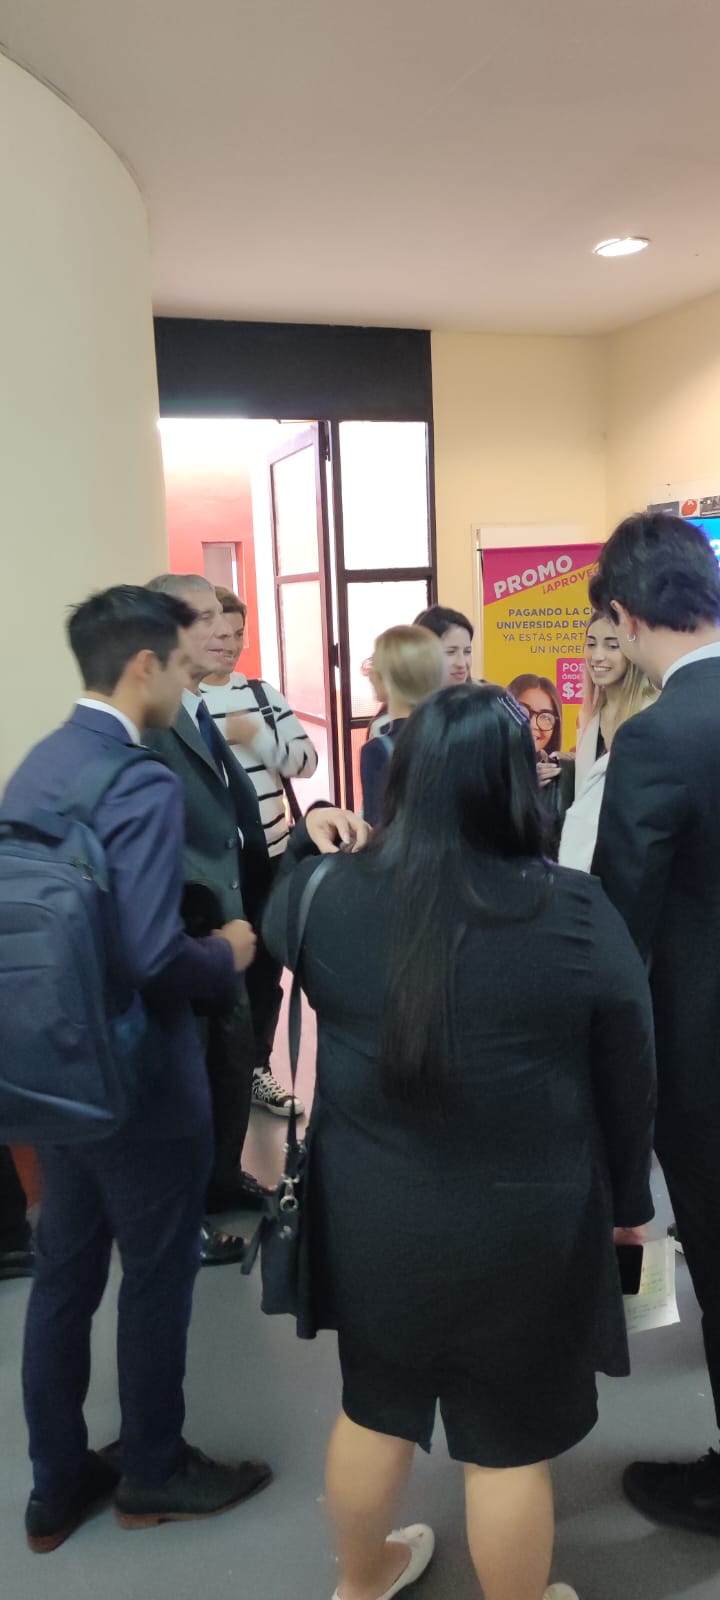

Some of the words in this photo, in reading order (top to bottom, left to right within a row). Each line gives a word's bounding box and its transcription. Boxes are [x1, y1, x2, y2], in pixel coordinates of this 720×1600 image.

[494, 555, 573, 599] PROMO
[509, 608, 562, 617] PAGANDO
[566, 608, 579, 616] LA
[497, 620, 569, 630] UNIVERSIDAD
[573, 620, 587, 628] EN
[504, 633, 515, 641] YA
[530, 645, 546, 654] UN
